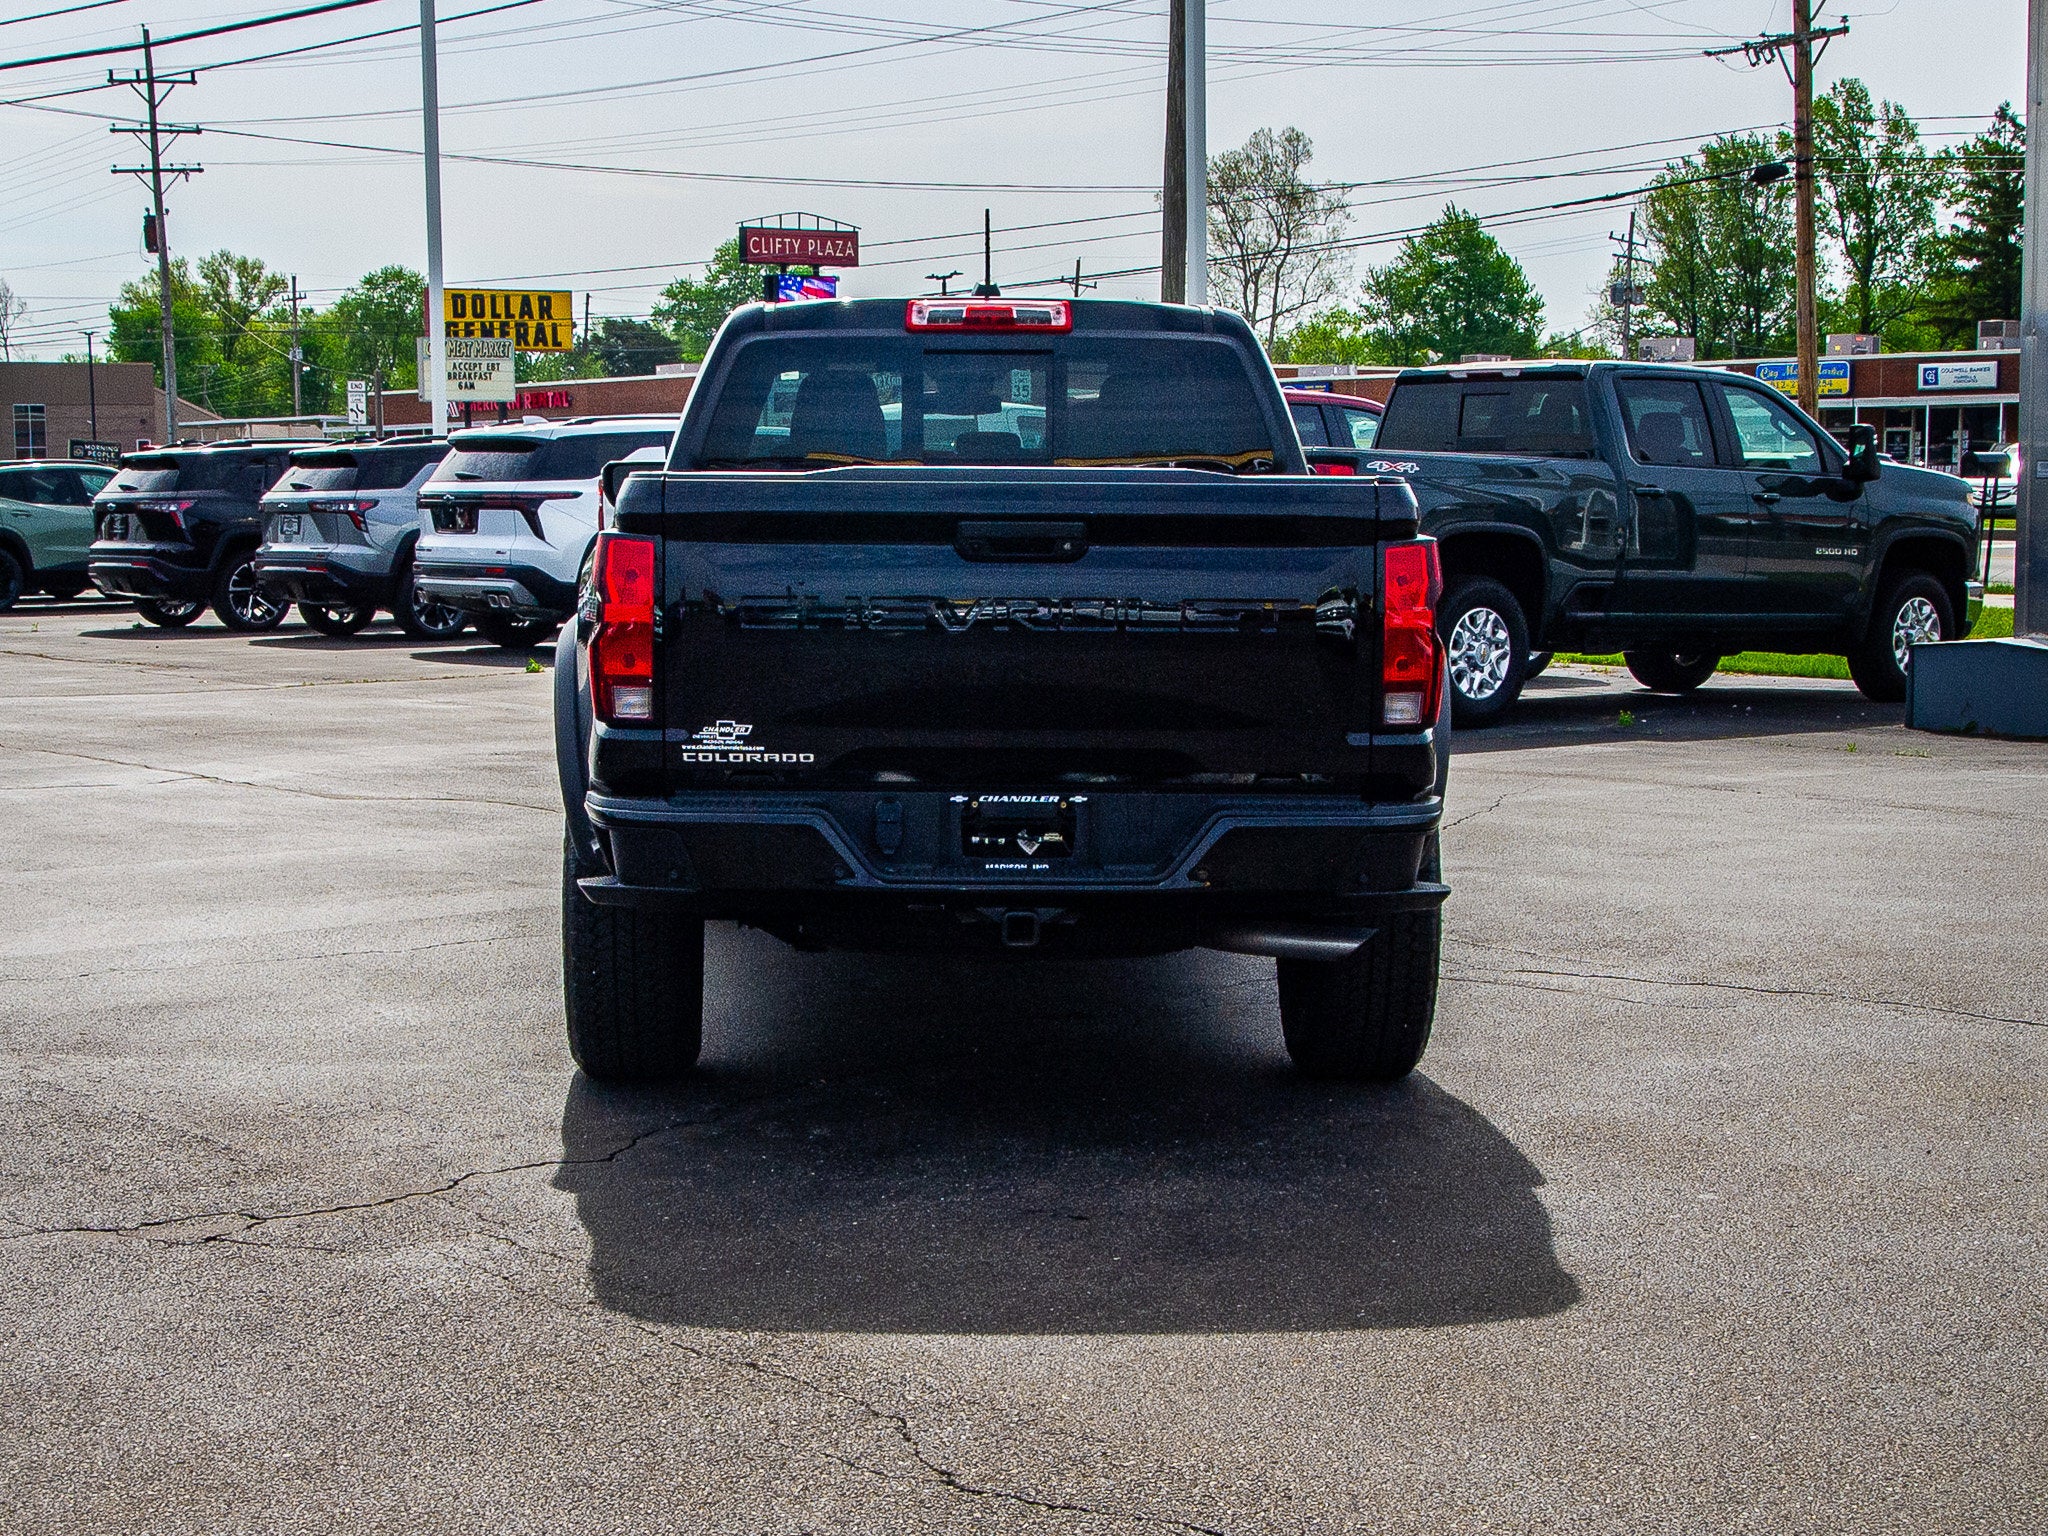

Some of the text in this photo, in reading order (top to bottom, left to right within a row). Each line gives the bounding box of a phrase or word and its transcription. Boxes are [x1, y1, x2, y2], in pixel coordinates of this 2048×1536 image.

[749, 236, 855, 257] CLIFTY PLAZA
[451, 293, 553, 319] DOLLAR
[445, 321, 563, 347] GENERAL
[447, 340, 473, 358] MEAT
[473, 340, 512, 358] MARKET
[452, 362, 500, 371] ACCEPT EBT
[447, 372, 492, 381] BREAKFAST
[350, 382, 363, 390] END
[457, 382, 476, 390] 6AM
[523, 391, 569, 409] RENTAL
[87, 450, 115, 458] PEOPLE
[739, 595, 1299, 632] CHEVROLET
[682, 752, 815, 762] COLORADO
[979, 795, 1060, 803] CHANDLER
